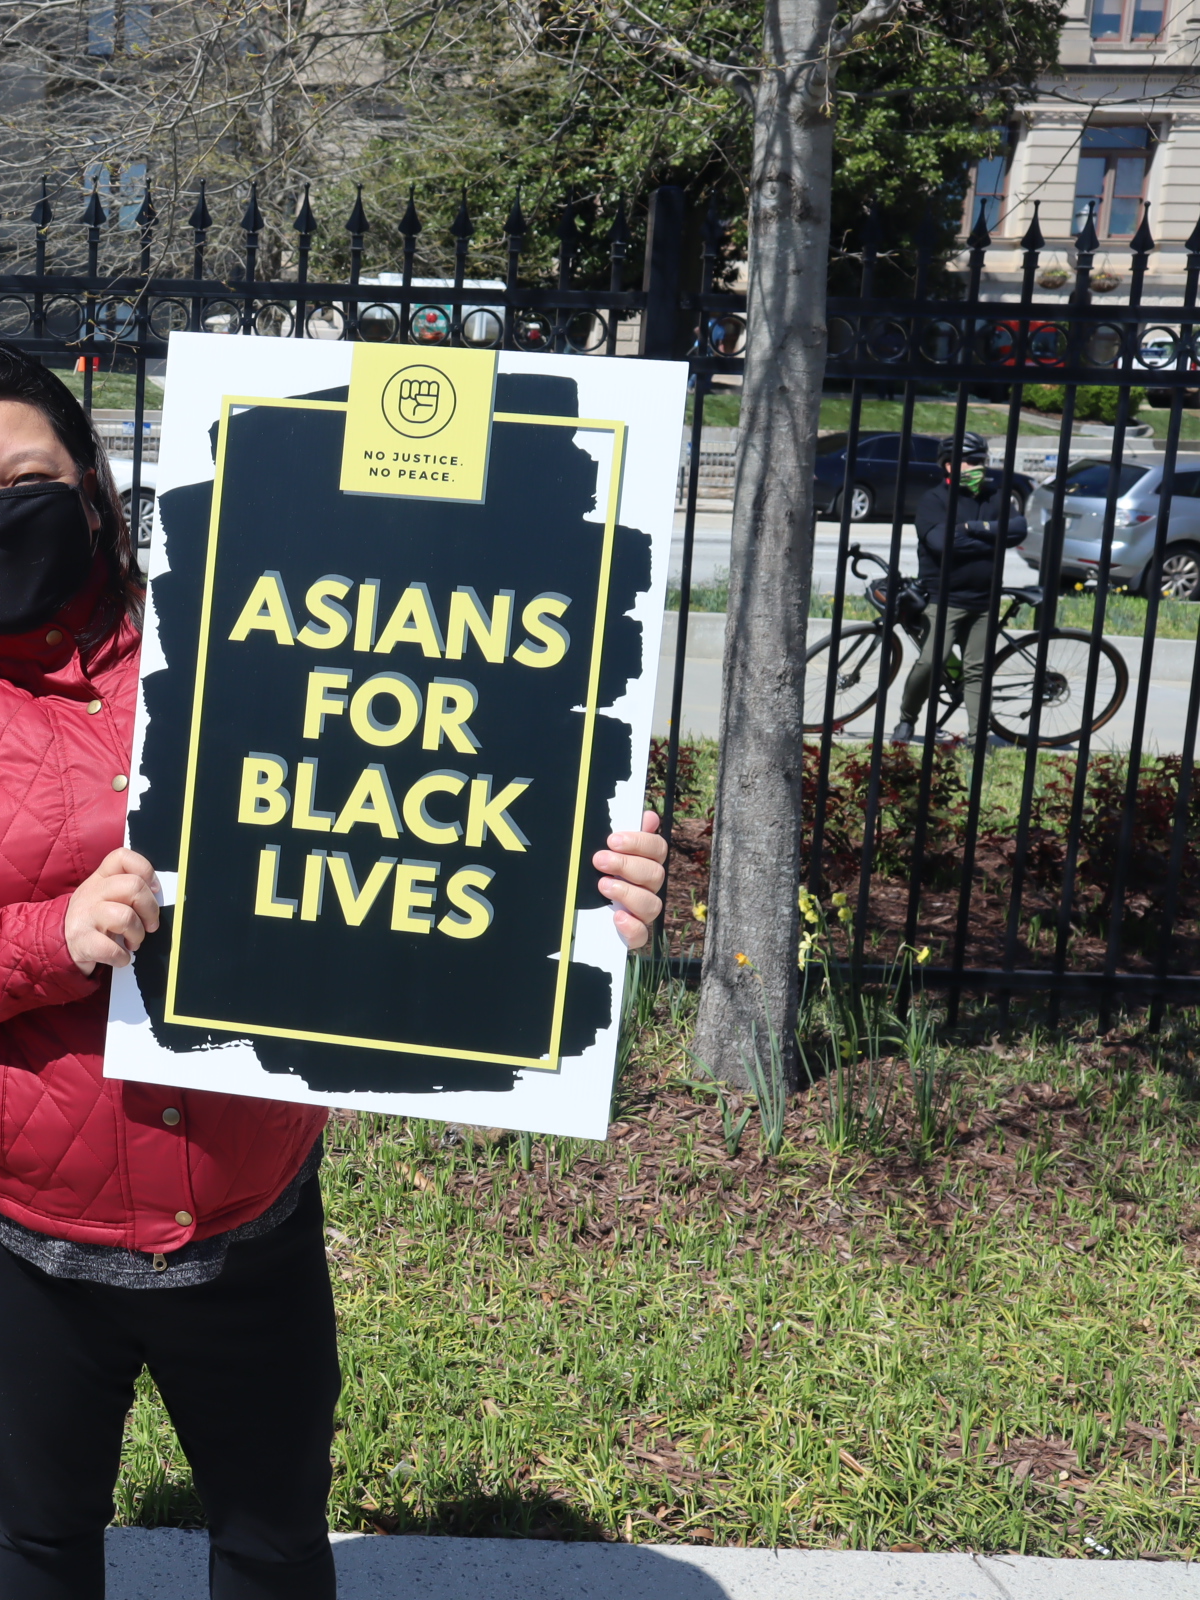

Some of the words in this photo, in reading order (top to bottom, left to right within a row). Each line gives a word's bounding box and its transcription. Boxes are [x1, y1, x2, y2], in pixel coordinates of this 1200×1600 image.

[364, 450, 386, 461] NO
[392, 452, 464, 467] JUSTICE.
[369, 467, 391, 478] NO
[398, 469, 455, 483] PEACE.
[228, 570, 572, 668] ASIANS
[303, 666, 483, 754] FOR
[238, 751, 534, 852] BLACK
[254, 844, 496, 939] LIVES
